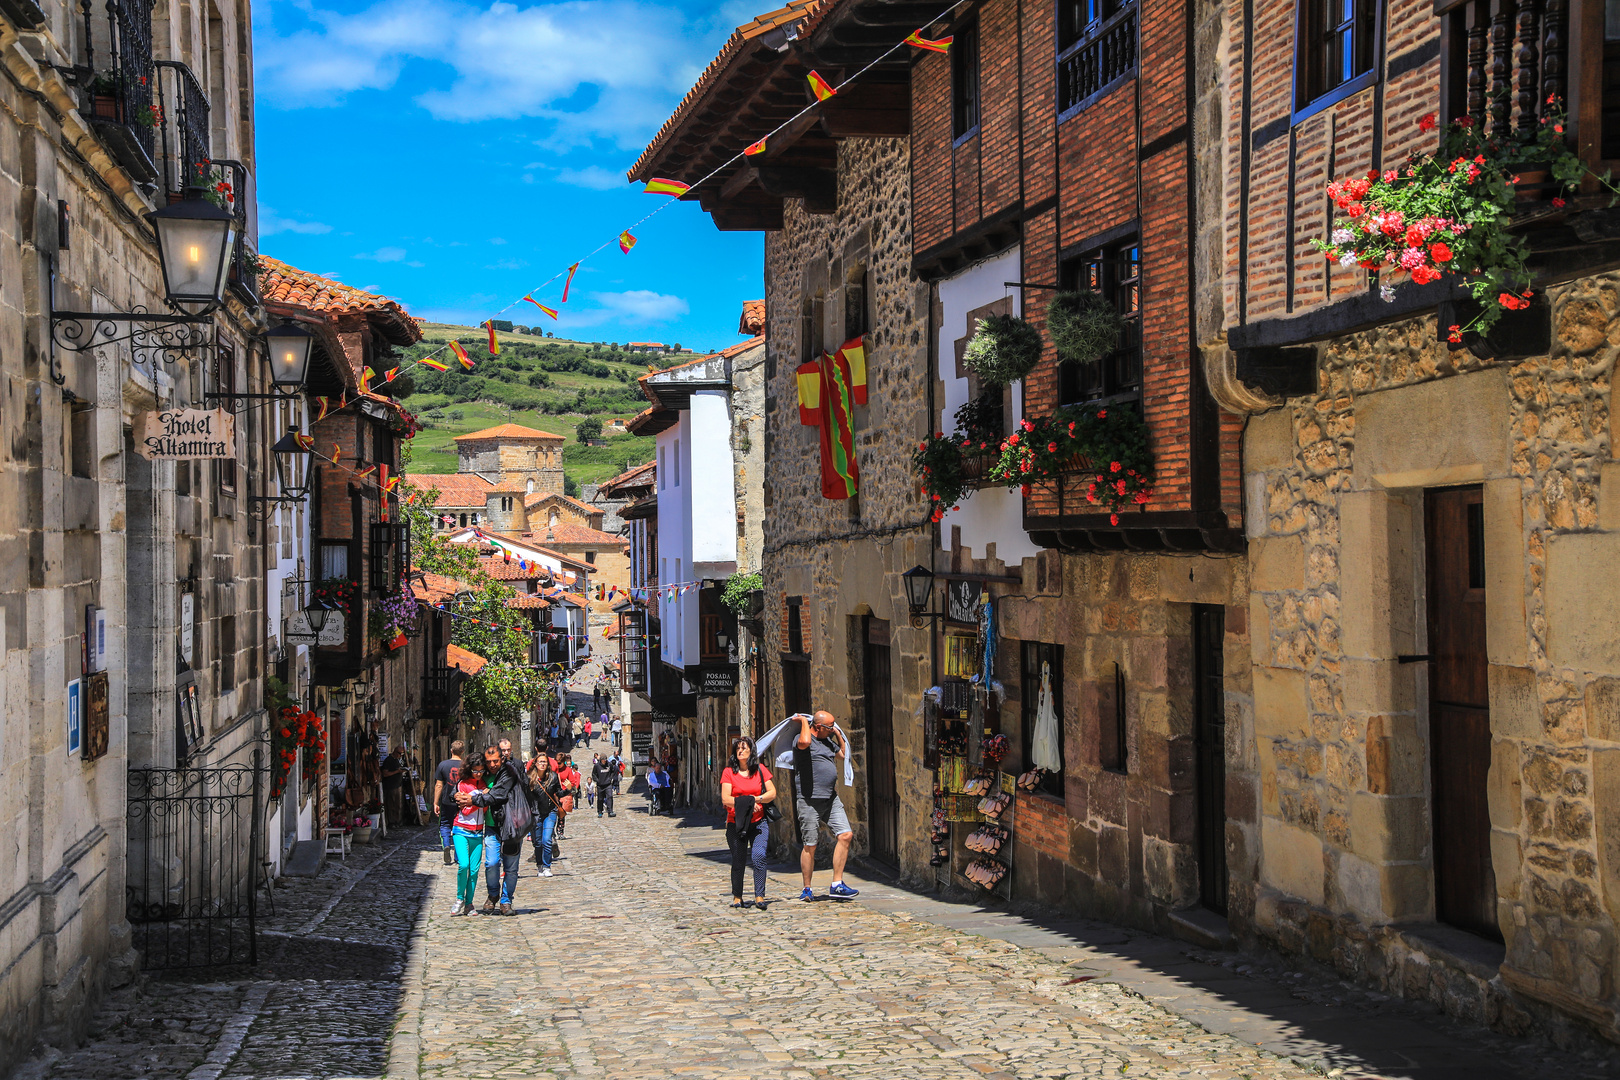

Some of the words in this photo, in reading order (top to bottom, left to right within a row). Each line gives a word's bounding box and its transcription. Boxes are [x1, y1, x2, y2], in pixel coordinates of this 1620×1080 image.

[157, 412, 211, 436] Hotel
[143, 434, 226, 456] Altamira
[71, 695, 77, 732] H
